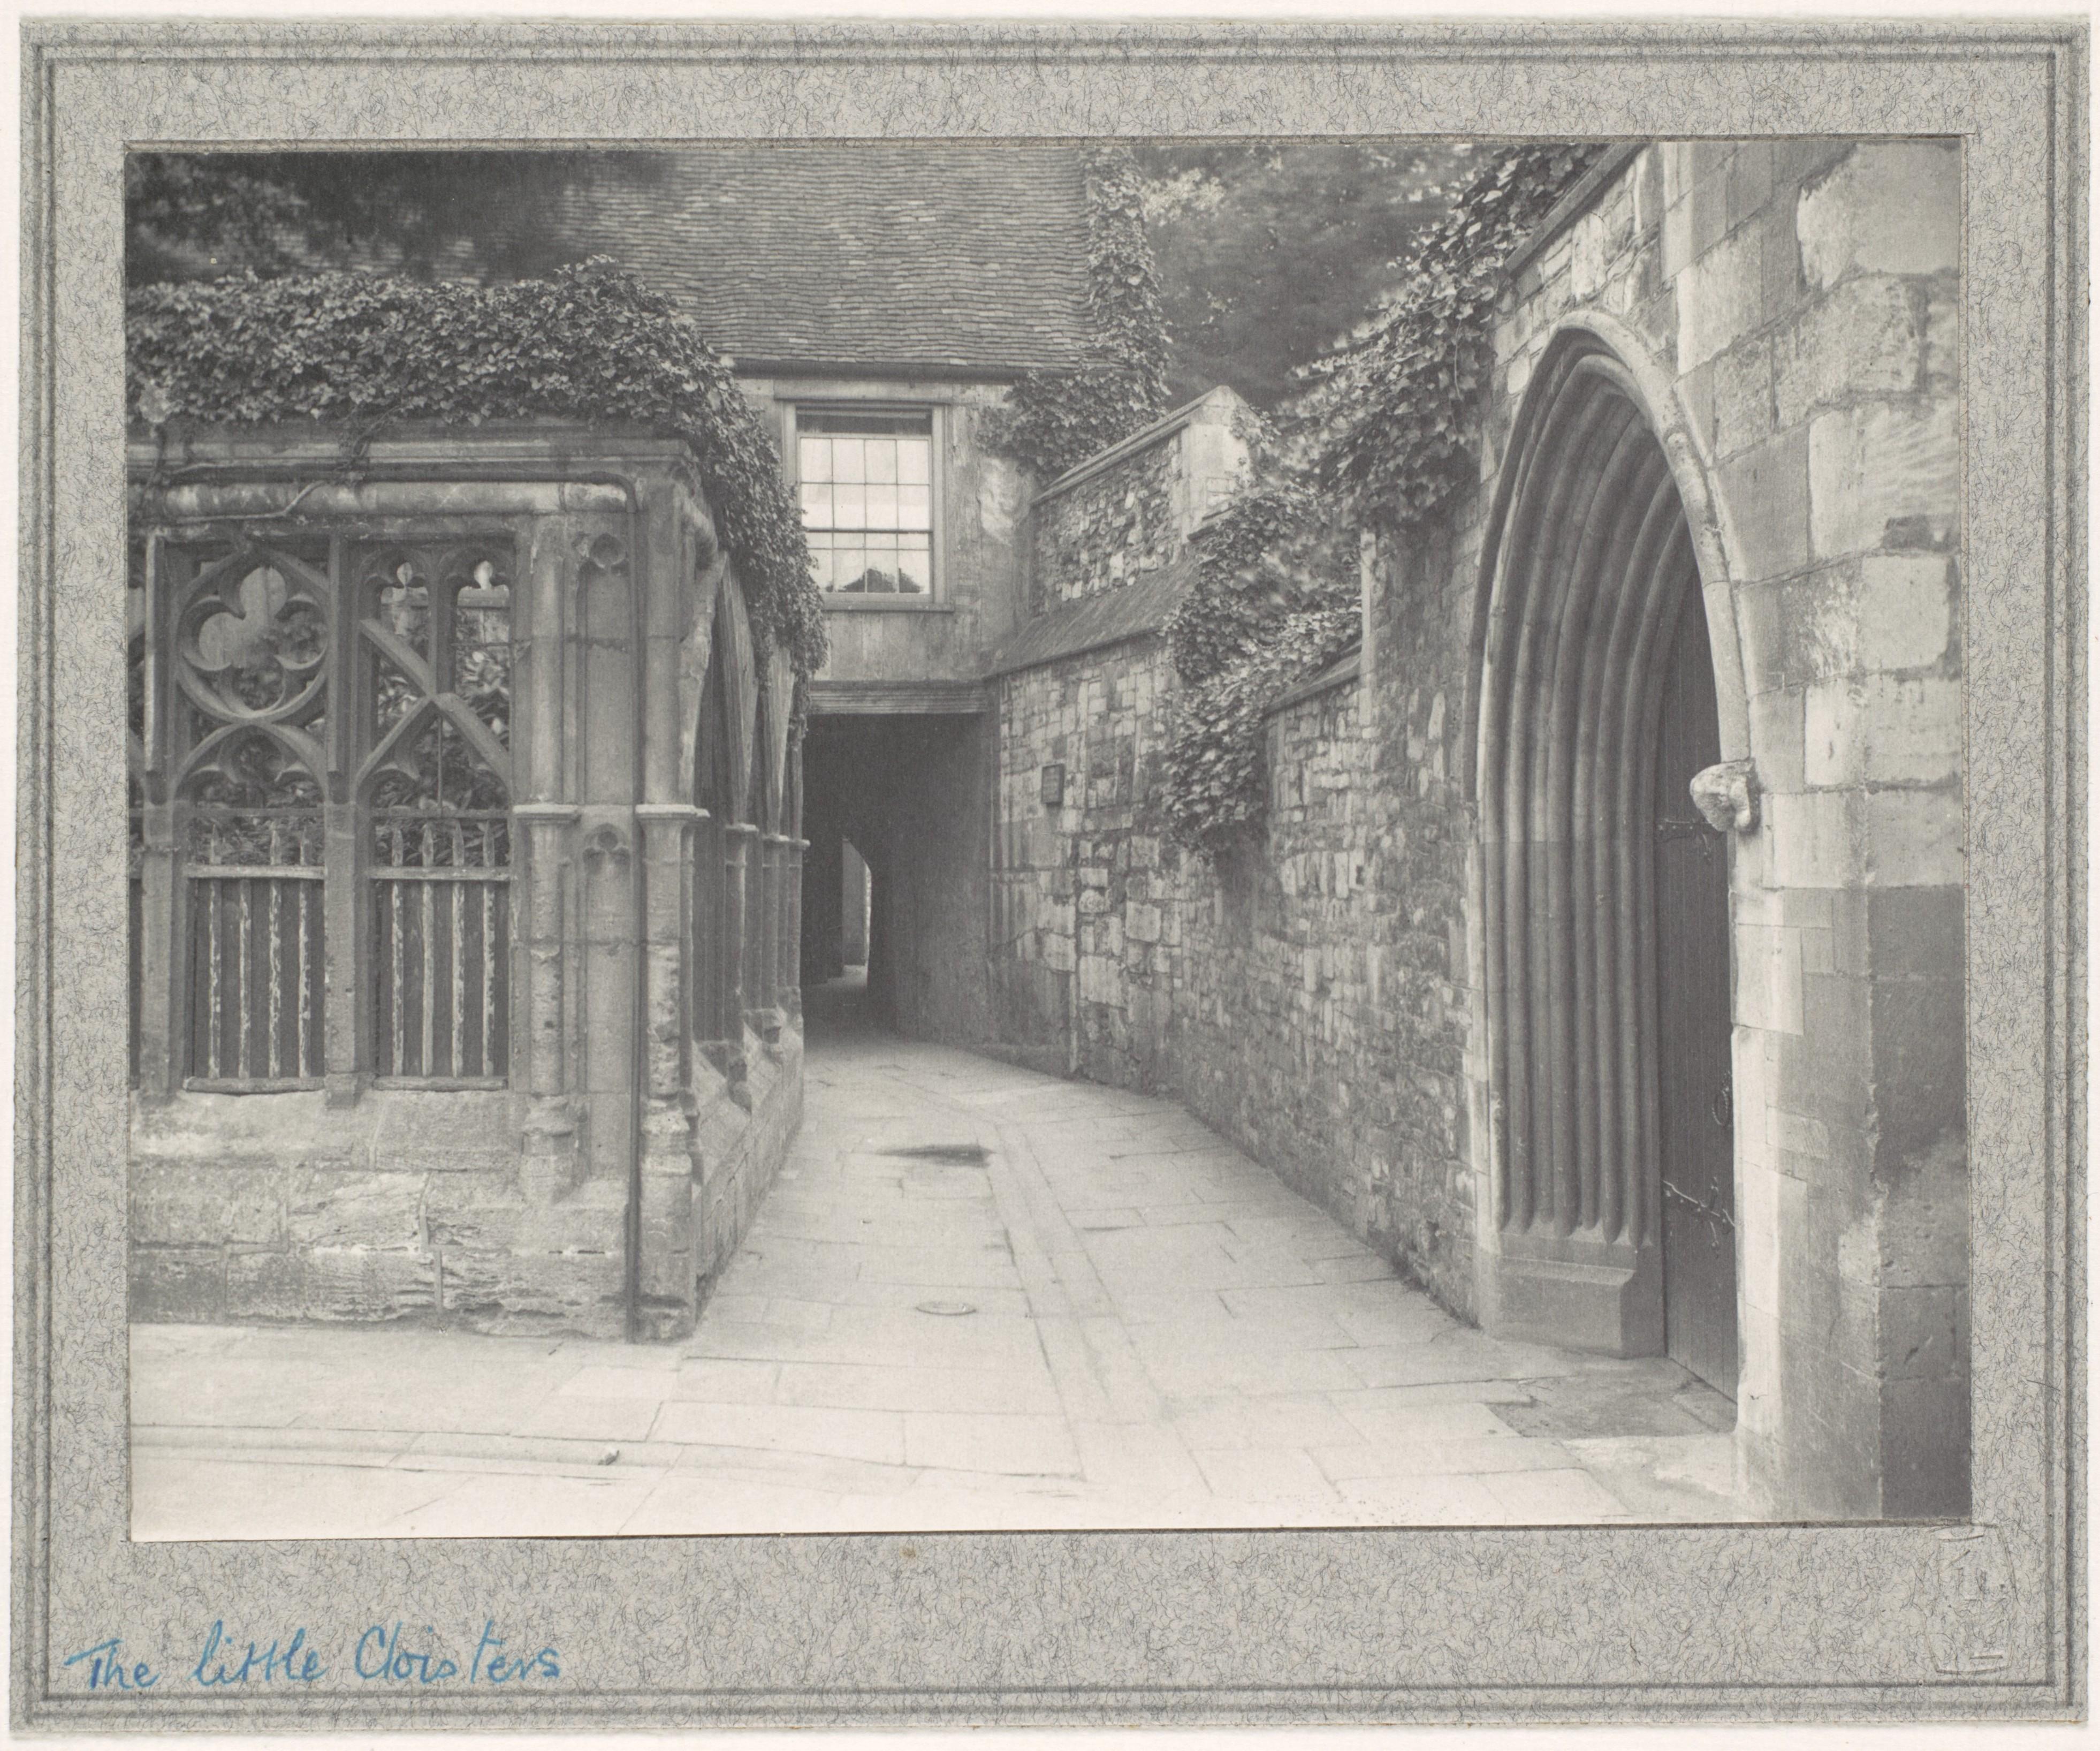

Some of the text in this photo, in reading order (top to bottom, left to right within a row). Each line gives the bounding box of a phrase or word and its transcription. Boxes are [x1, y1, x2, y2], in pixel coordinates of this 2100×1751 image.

[64, 1619, 561, 1690] The little Cloisters
